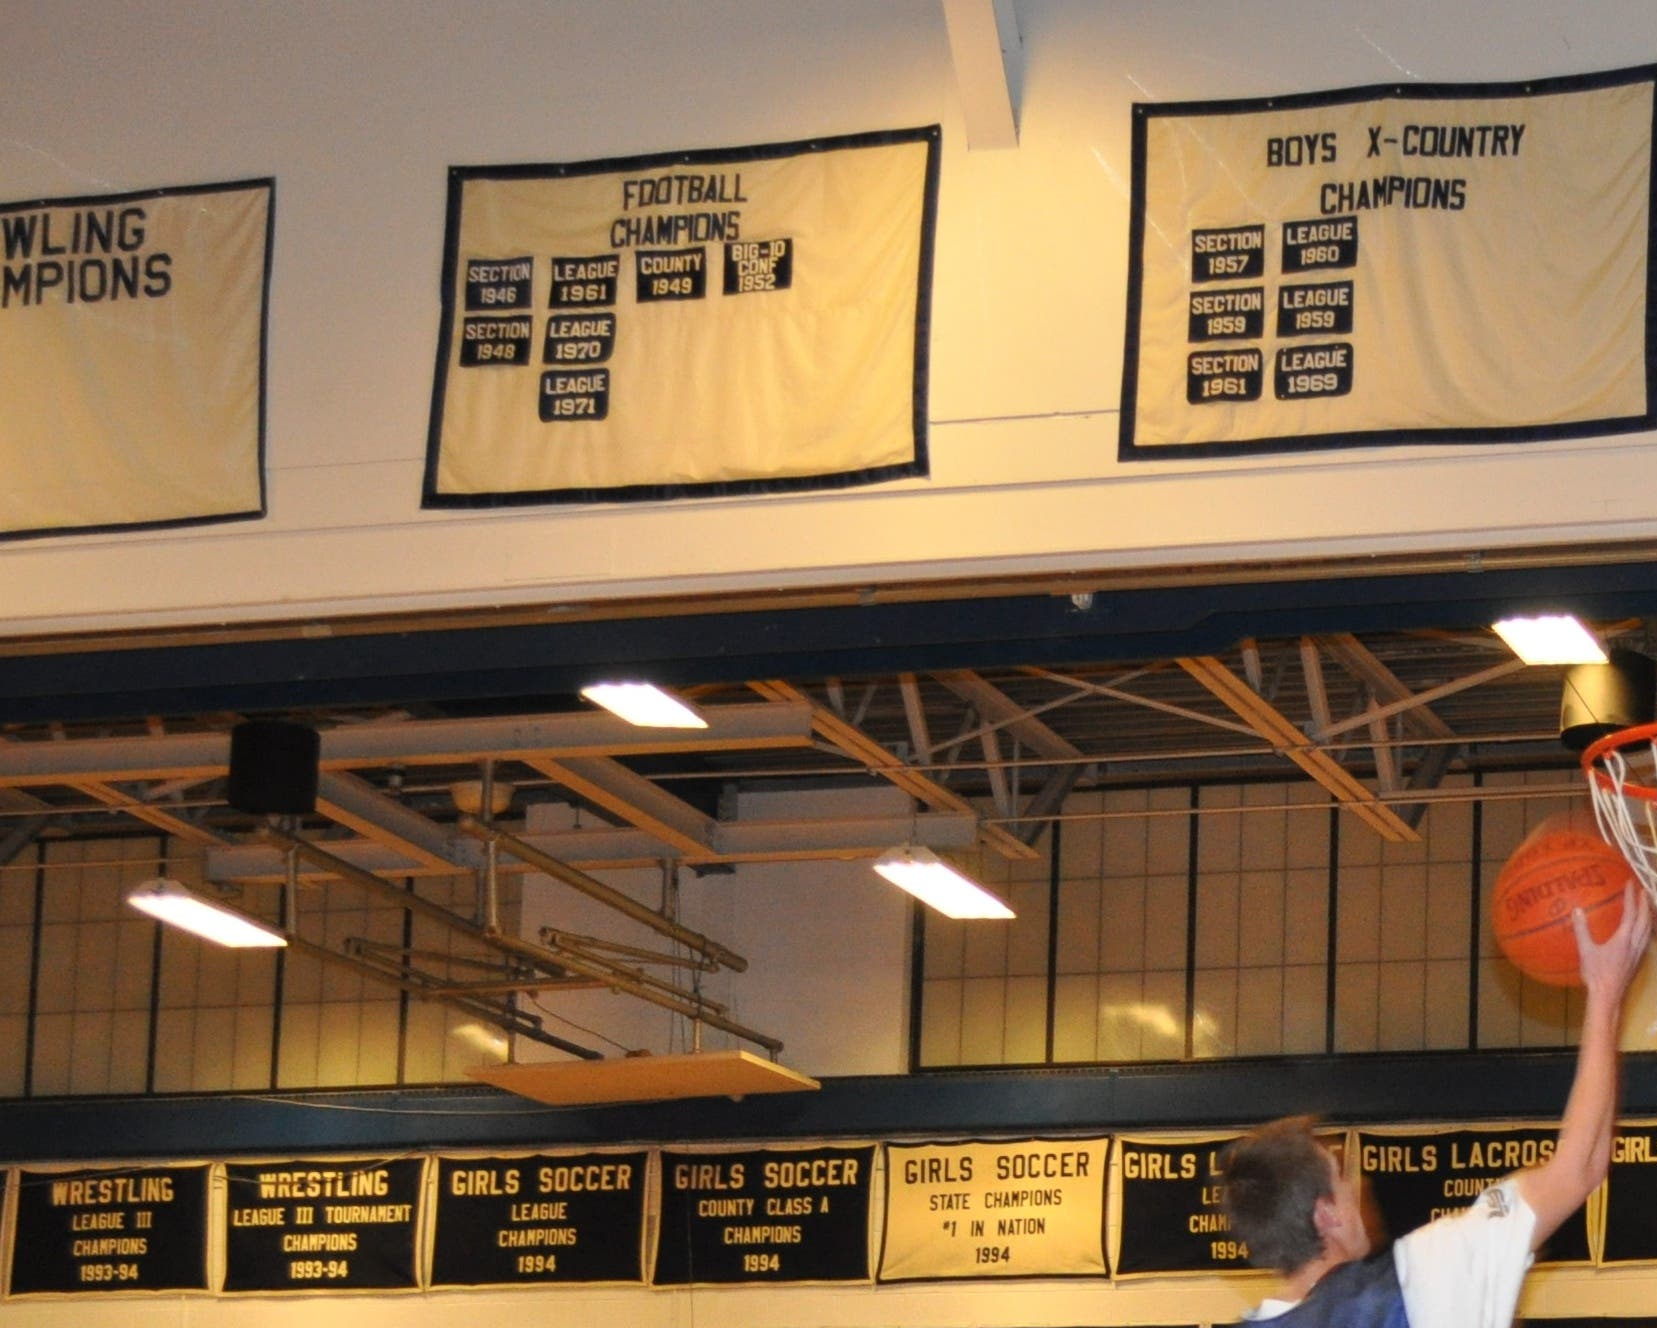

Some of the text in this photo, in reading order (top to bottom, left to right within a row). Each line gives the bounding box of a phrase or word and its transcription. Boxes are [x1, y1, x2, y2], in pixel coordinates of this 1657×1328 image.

[1267, 124, 1526, 167] BOYS X-COUNTRY
[623, 173, 748, 210] FOOTBALL
[1320, 175, 1466, 214] CHAMPIONS
[2, 208, 147, 260] WLING
[611, 211, 741, 248] CHAMPIONS
[1286, 222, 1353, 246] LEAGUE
[731, 240, 786, 261] BIG-10
[1195, 232, 1261, 253] SECTION
[640, 253, 702, 275] COUNTY
[1208, 255, 1249, 274] 1957
[1300, 244, 1339, 266] 1960
[468, 262, 530, 283] SECTION
[553, 260, 618, 281] LEAGUE
[738, 258, 778, 276] CONF
[2, 253, 173, 309] MPIONS
[652, 277, 693, 295] 1949
[738, 274, 777, 292] 1952
[481, 287, 517, 304] 1946
[561, 284, 606, 301] 1961
[1283, 287, 1350, 309] LEAGUE
[1191, 292, 1261, 314] SECTION
[549, 319, 612, 339] LEAGUE
[1207, 316, 1246, 335] 1959
[1296, 309, 1335, 329] 1959
[465, 321, 530, 340] SECTION
[477, 343, 515, 360] 1948
[555, 341, 601, 360] 1970
[1281, 350, 1347, 371] LEAGUE
[1191, 355, 1259, 375] SECTION
[545, 374, 606, 394] LEAGUE
[1202, 377, 1246, 397] 1961
[1287, 373, 1338, 393] 1969
[552, 398, 596, 416] 1971
[1124, 1152, 1196, 1180] GIRLS
[1363, 1143, 1438, 1172] GIRLS
[675, 1159, 859, 1191] GIRLS SOCCER
[905, 1151, 1090, 1185] GIRLS SOCCER
[259, 1170, 389, 1199] WRESTLING
[451, 1165, 631, 1196] GIRLS SOCCER
[52, 1178, 174, 1206] WRESTLING
[929, 1189, 1063, 1212] STATE CHAMPIONS
[234, 1204, 412, 1227] LEAGUE TOURNAMENT
[511, 1203, 567, 1222] LEAGUE
[699, 1198, 812, 1218] COUNTY CLASS
[73, 1213, 124, 1232] LEAGUE
[971, 1218, 1045, 1238] IN NATION
[283, 1233, 357, 1252] CHAMPIONS
[499, 1229, 577, 1248] CHAMPIONS
[724, 1226, 802, 1245] CHAMPIONS
[73, 1238, 147, 1257] CHAMPIONS
[975, 1246, 1010, 1263] 1994
[1211, 1241, 1249, 1260] 1994
[81, 1264, 138, 1281] 1993-94
[290, 1262, 348, 1278] 1993-94
[518, 1255, 556, 1273] 1994
[743, 1254, 780, 1272] 1994
